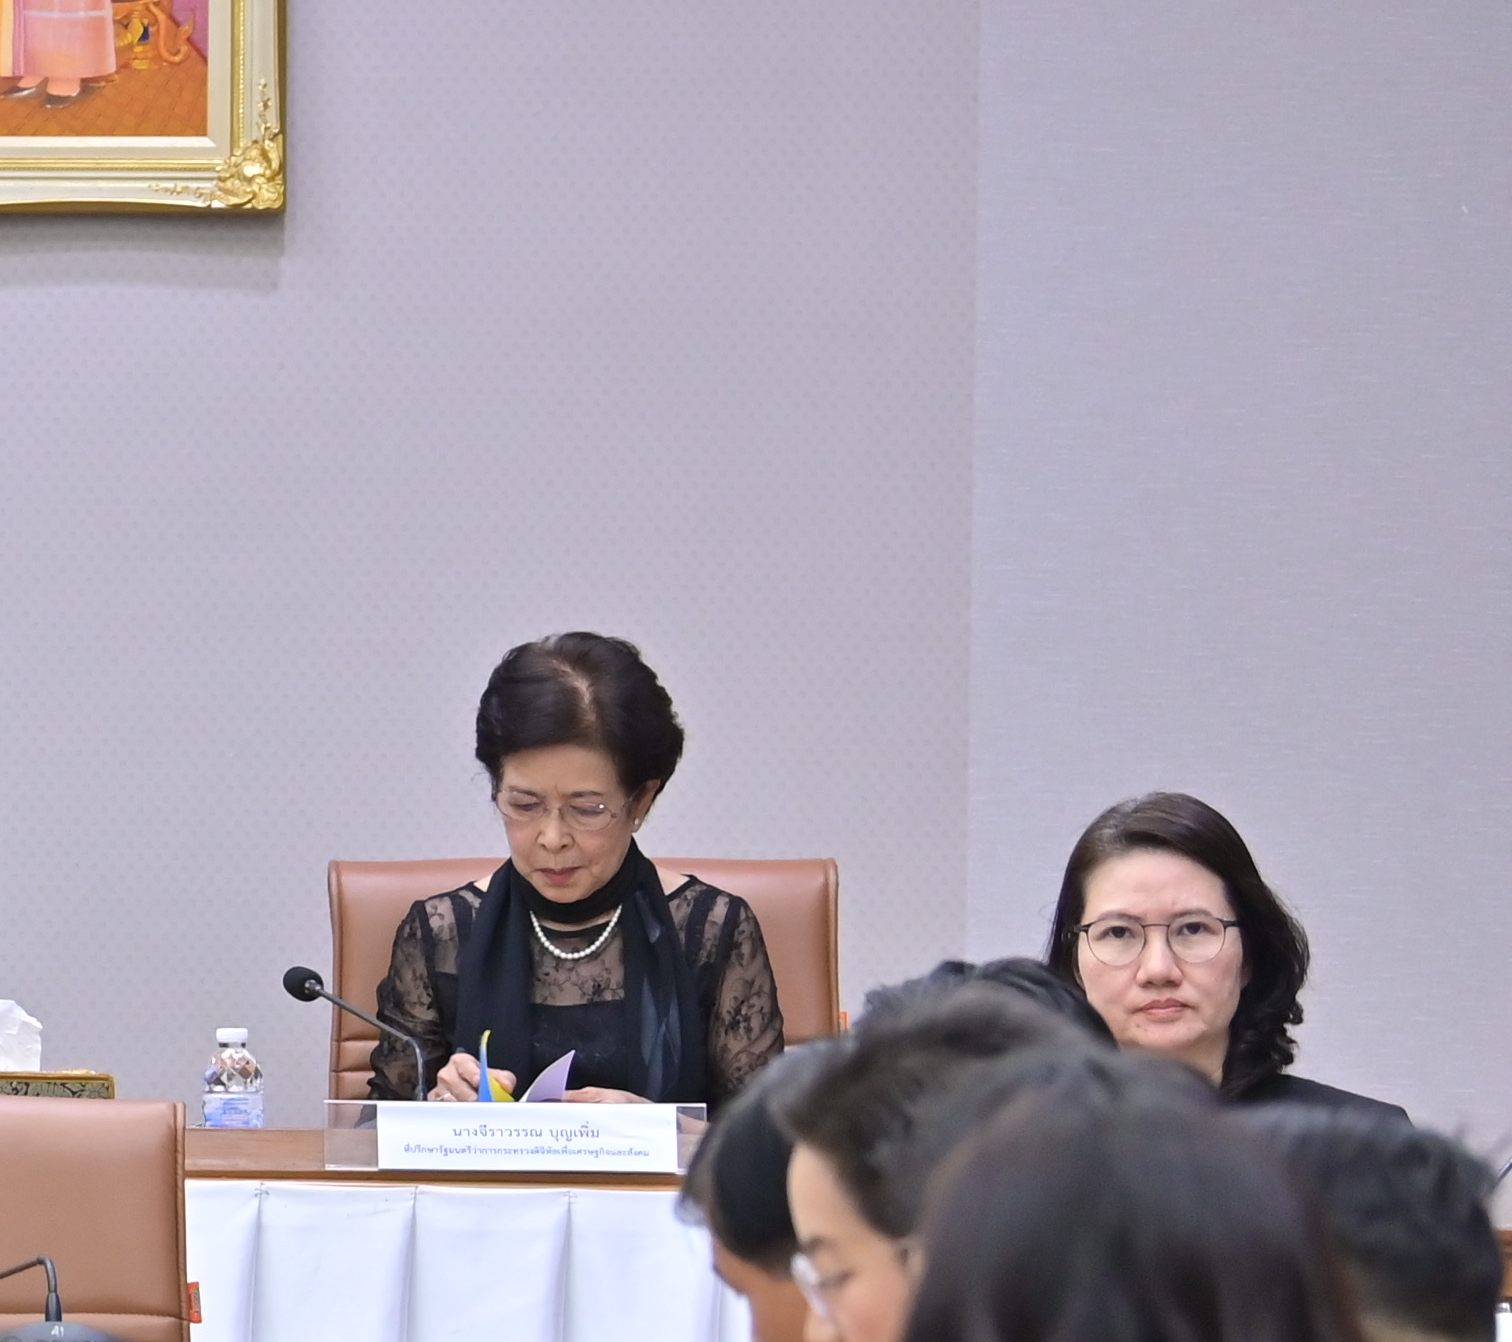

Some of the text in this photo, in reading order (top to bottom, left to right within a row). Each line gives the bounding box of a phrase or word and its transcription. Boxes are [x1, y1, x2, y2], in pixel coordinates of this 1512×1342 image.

[452, 1121, 600, 1142] นางจีราวรรณ บุญเพิ่ม
